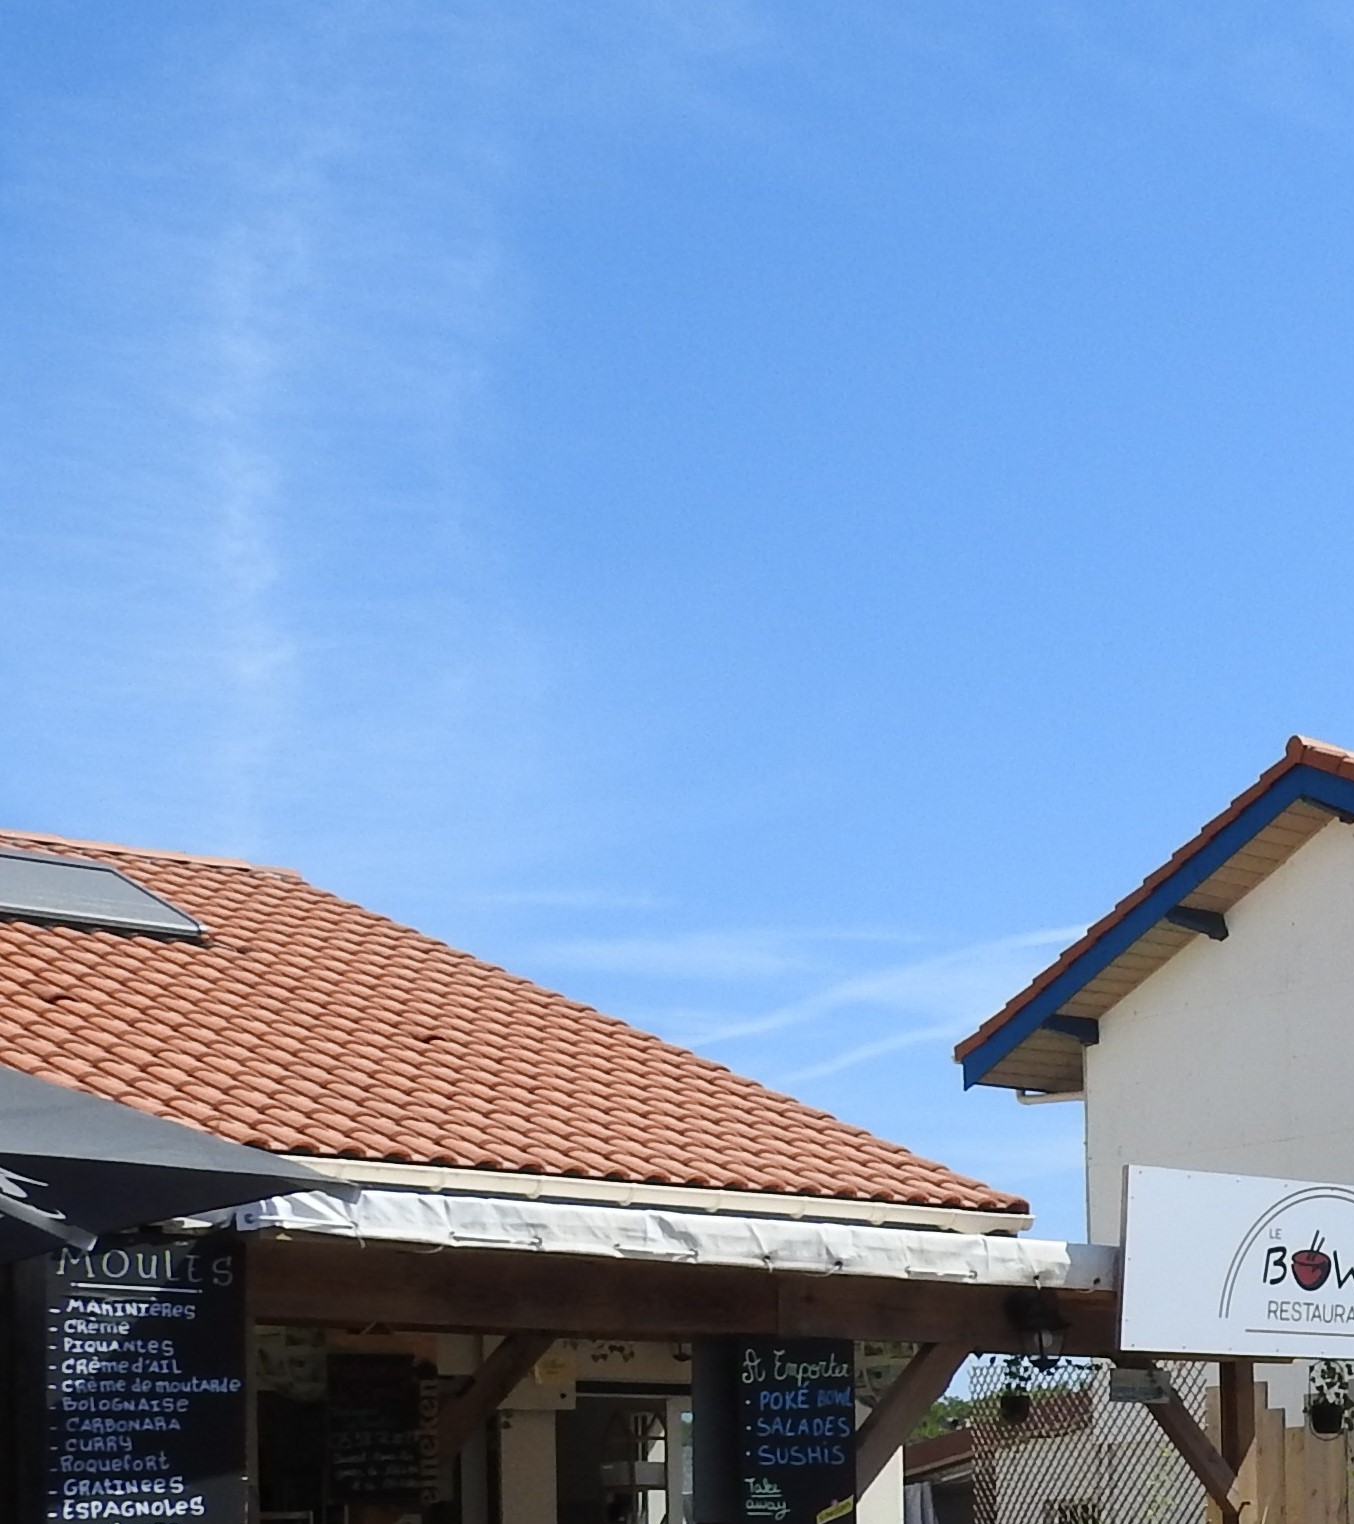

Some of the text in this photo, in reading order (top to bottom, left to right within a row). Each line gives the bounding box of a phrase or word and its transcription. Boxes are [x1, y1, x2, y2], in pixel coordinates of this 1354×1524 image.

[1269, 1228, 1282, 1240] LE
[759, 1381, 810, 1410] POKÉ
[756, 1416, 850, 1437] SALADES
[744, 1477, 781, 1494] Take
[746, 1499, 791, 1521] away
